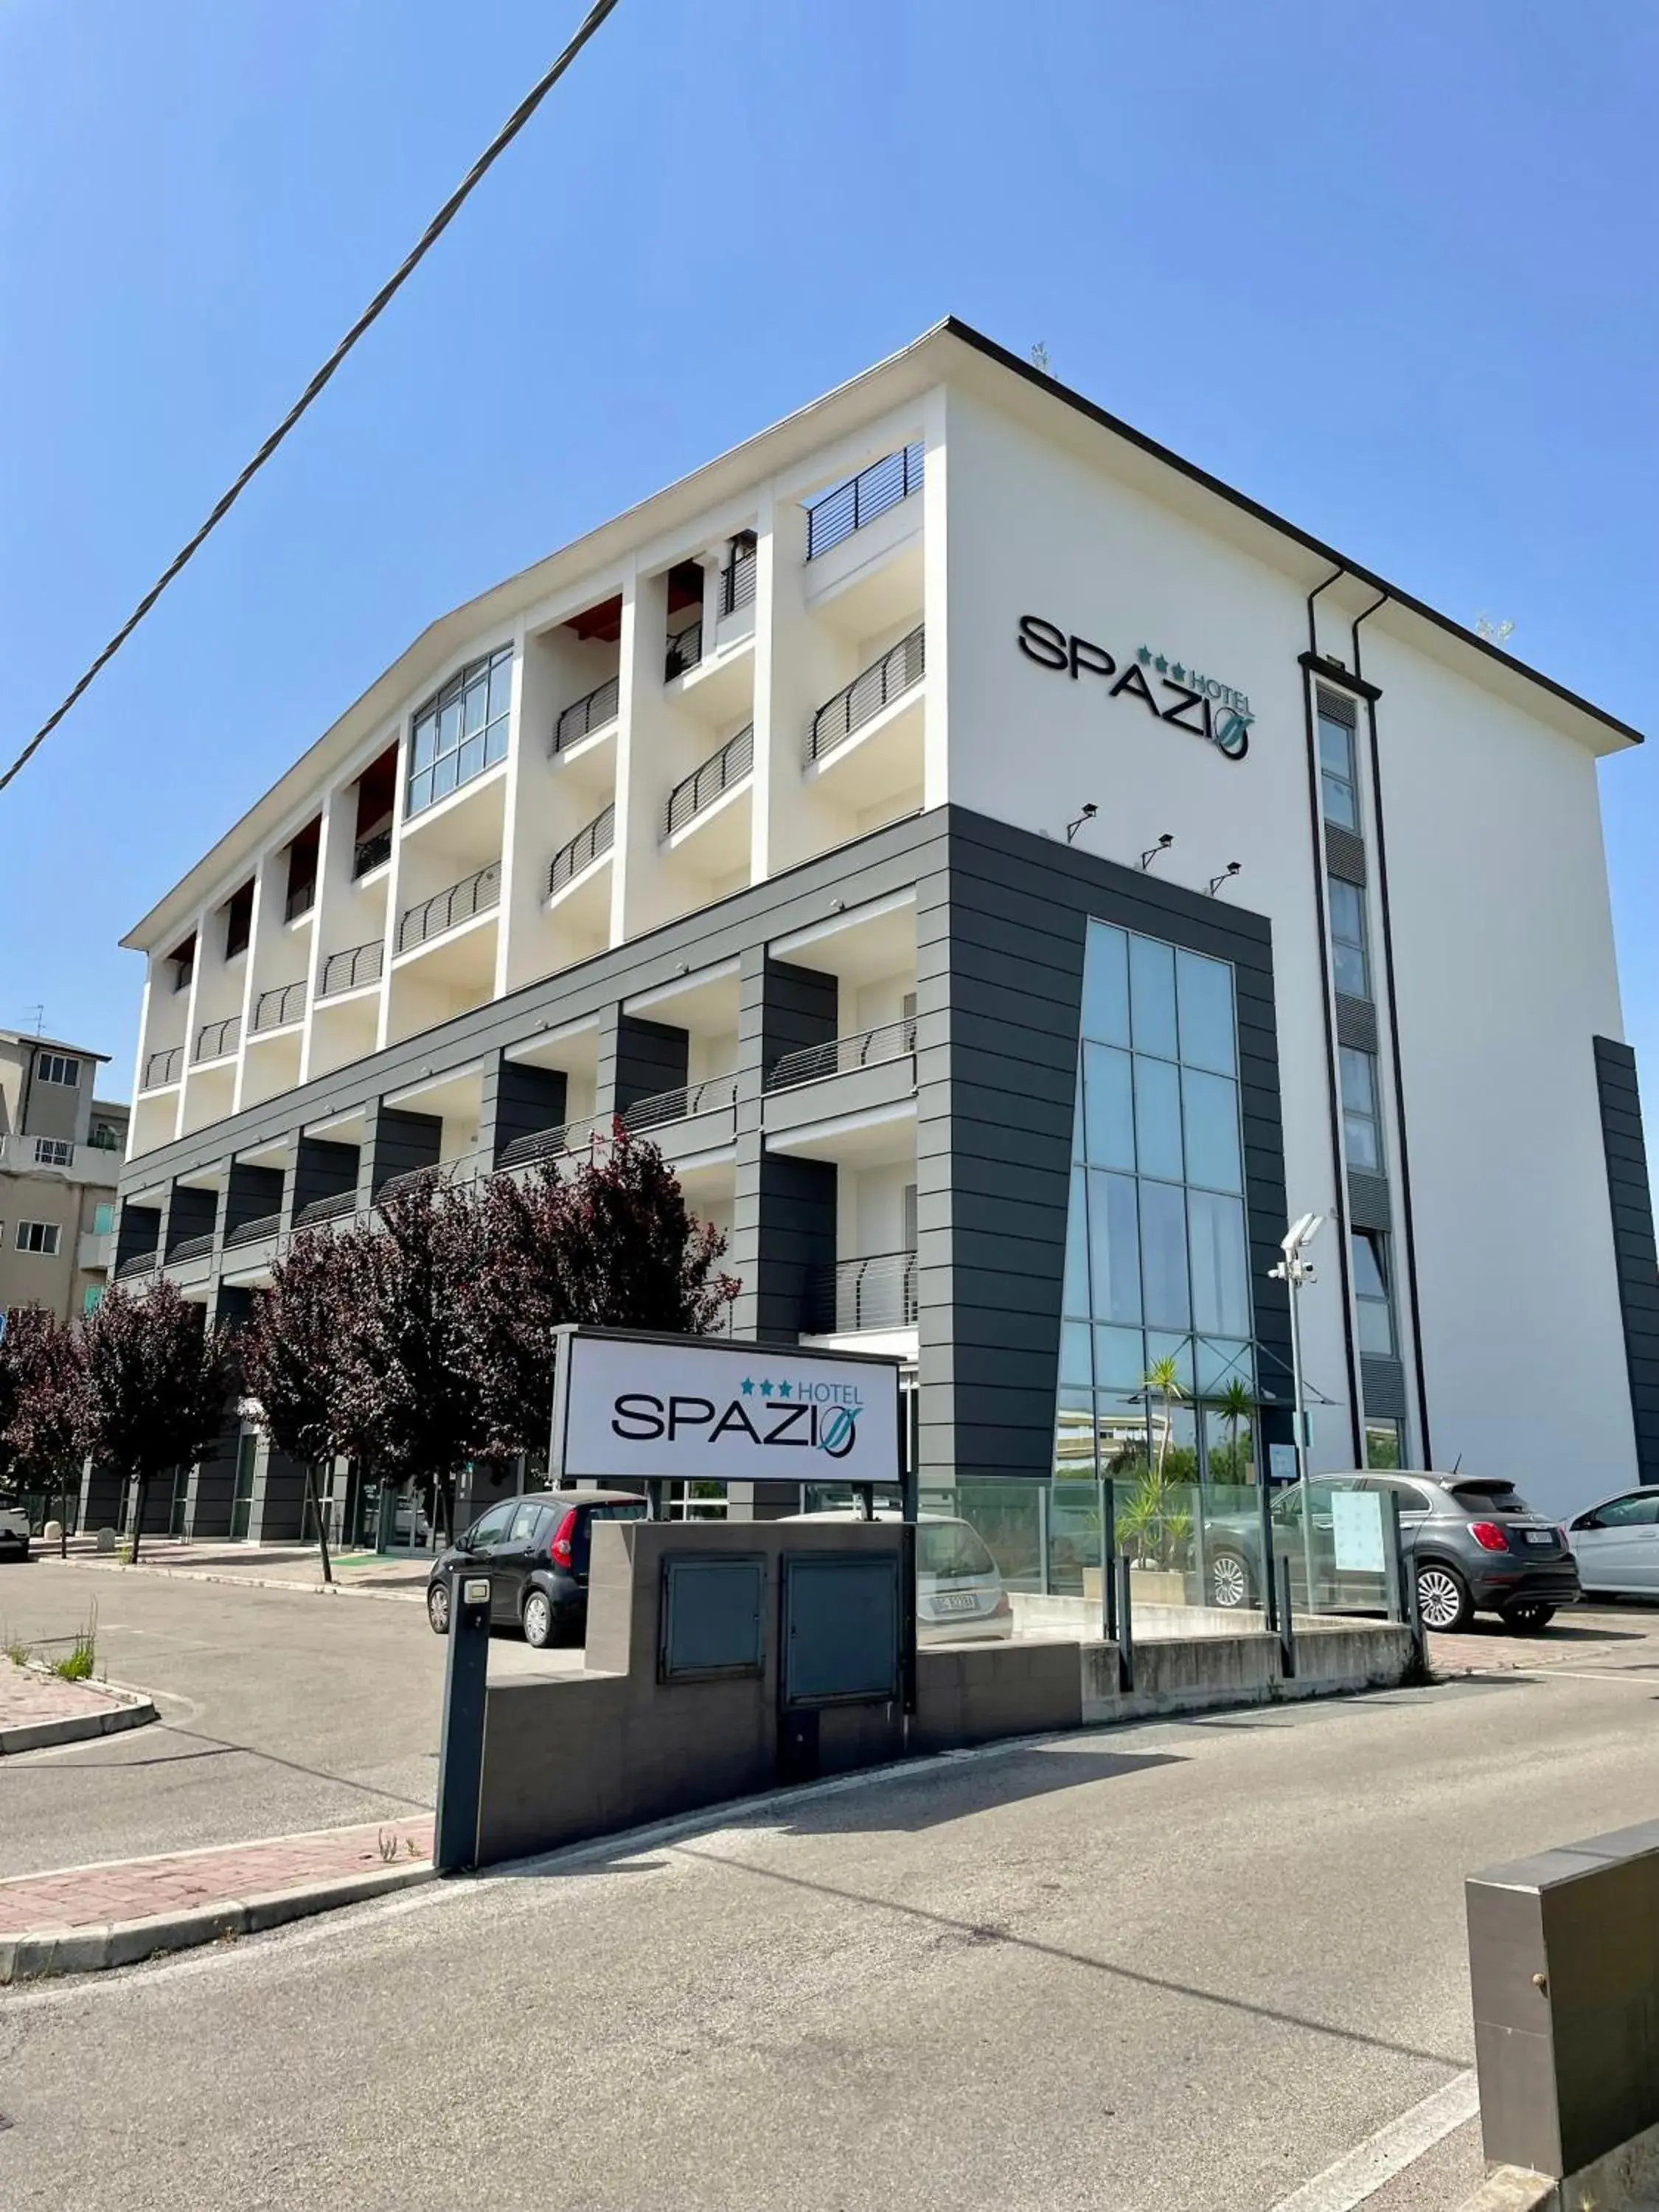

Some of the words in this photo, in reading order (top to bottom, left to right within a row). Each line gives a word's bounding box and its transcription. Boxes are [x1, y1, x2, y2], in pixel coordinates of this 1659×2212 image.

[1018, 614, 1250, 761] SPAZIO
[1190, 669, 1255, 717] HOTEL
[799, 1380, 864, 1405] HOTEL
[611, 1394, 856, 1458] SPAZIO
